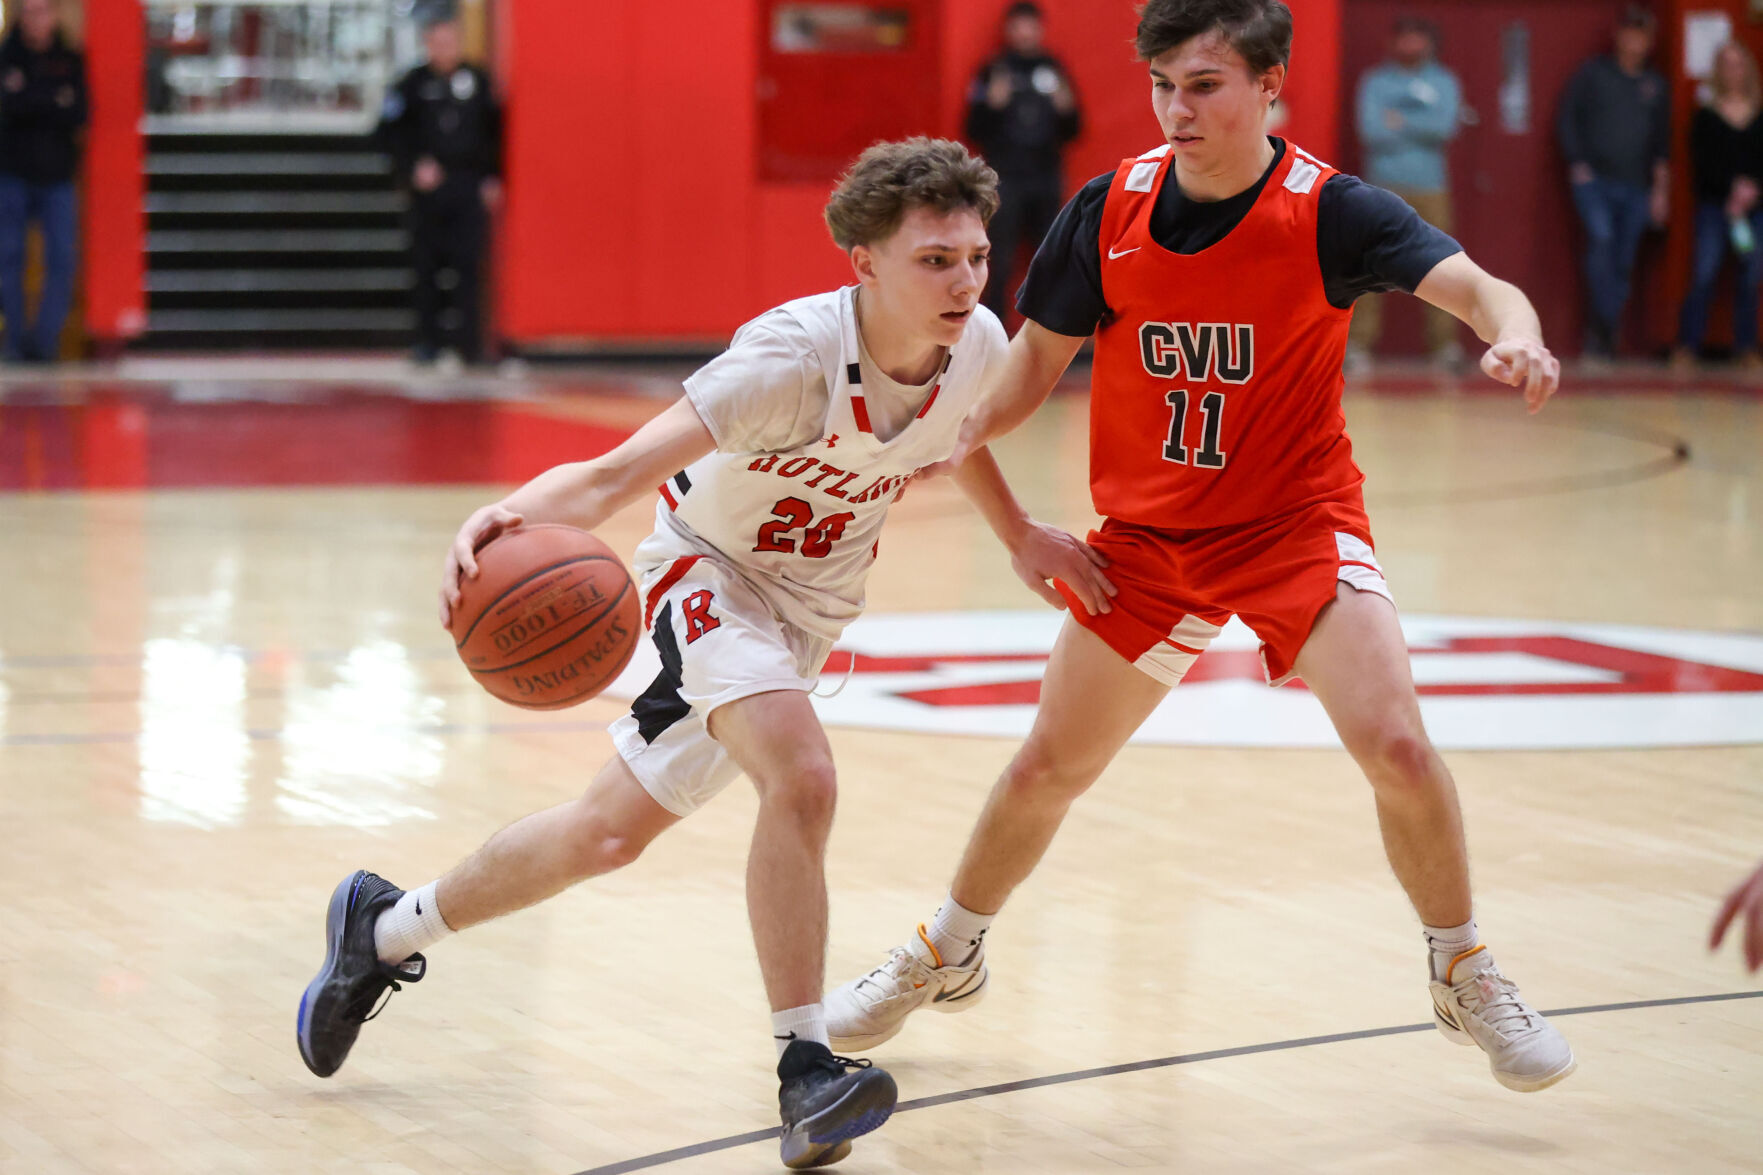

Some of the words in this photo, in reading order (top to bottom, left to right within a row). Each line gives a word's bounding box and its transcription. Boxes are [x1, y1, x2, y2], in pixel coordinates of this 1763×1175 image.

[1138, 321, 1254, 385] CVU
[1162, 389, 1226, 469] 11
[752, 496, 856, 558] 20
[494, 583, 606, 651] TF-1000
[682, 589, 721, 645] R
[513, 614, 629, 695] SPALDING
